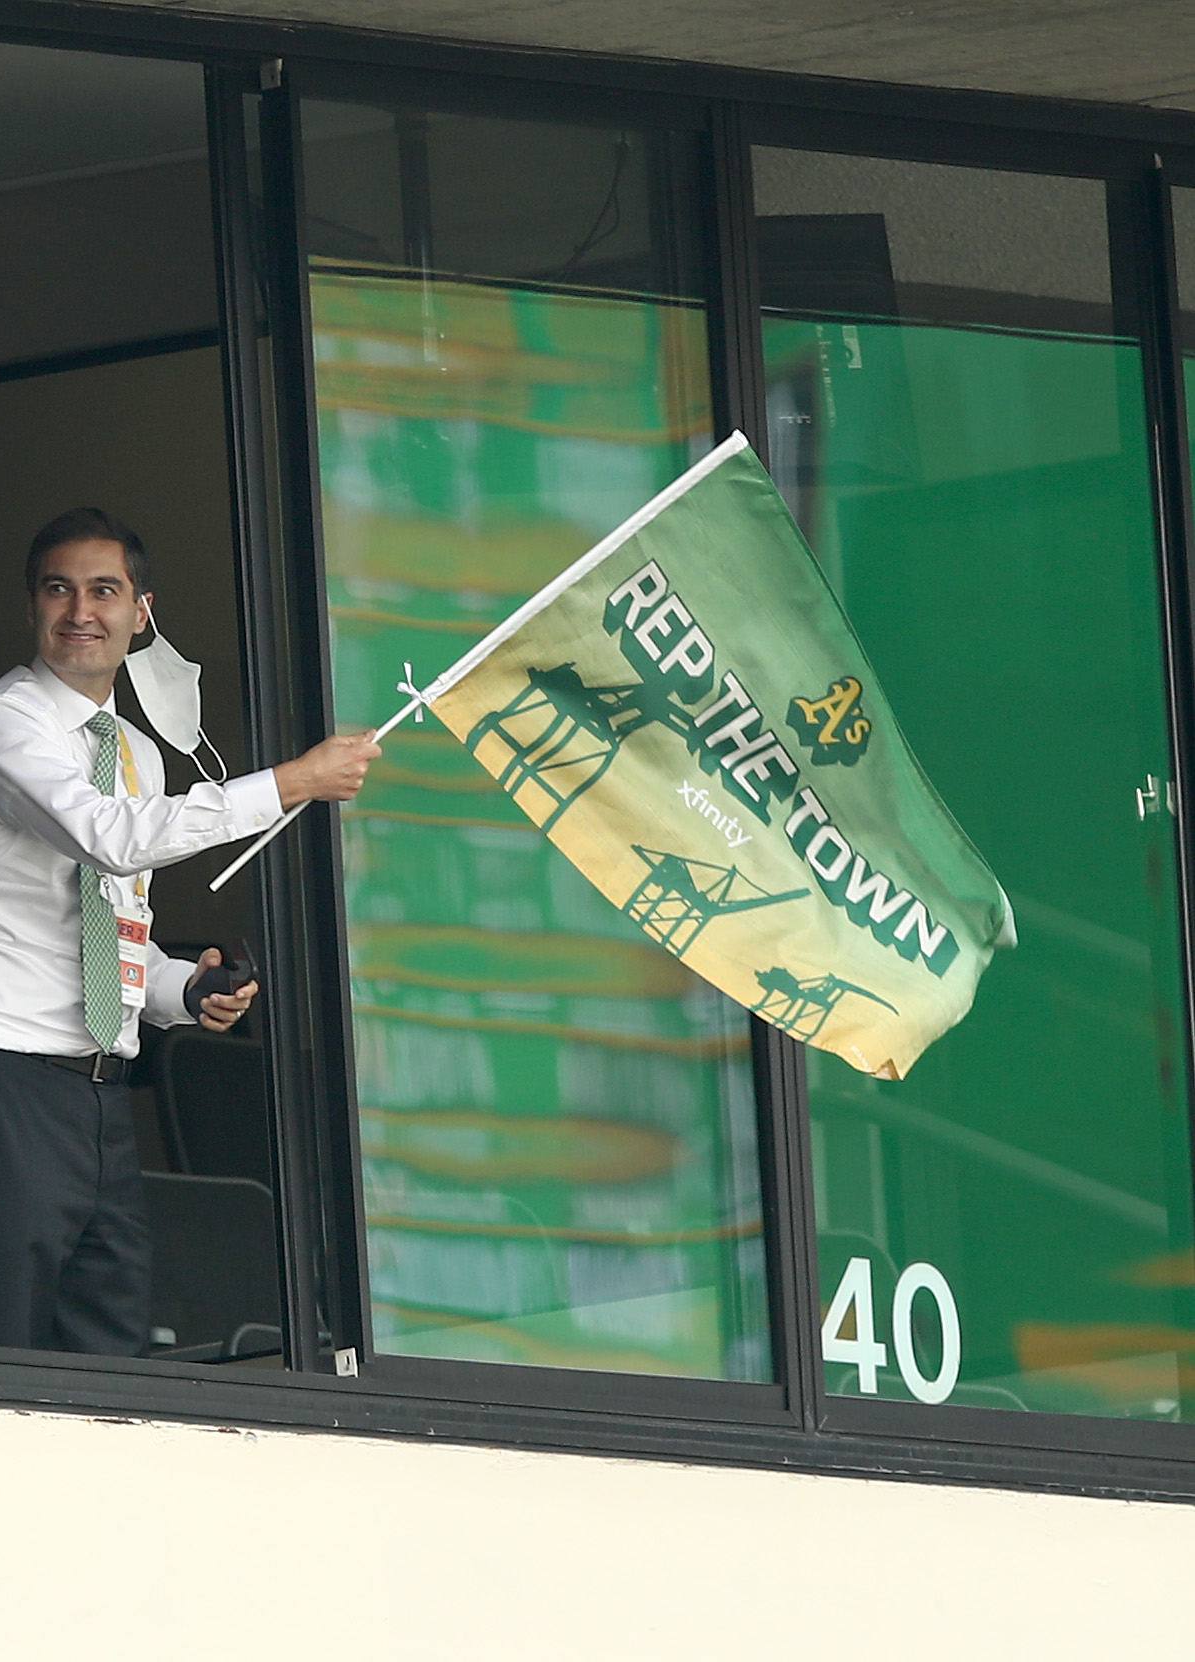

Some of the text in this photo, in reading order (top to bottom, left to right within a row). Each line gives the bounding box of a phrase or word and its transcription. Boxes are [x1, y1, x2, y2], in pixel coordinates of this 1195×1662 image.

[607, 558, 949, 958] REP THE TOWN
[675, 779, 753, 848] xfinity
[118, 923, 134, 938] ER
[820, 1256, 962, 1405] 40
